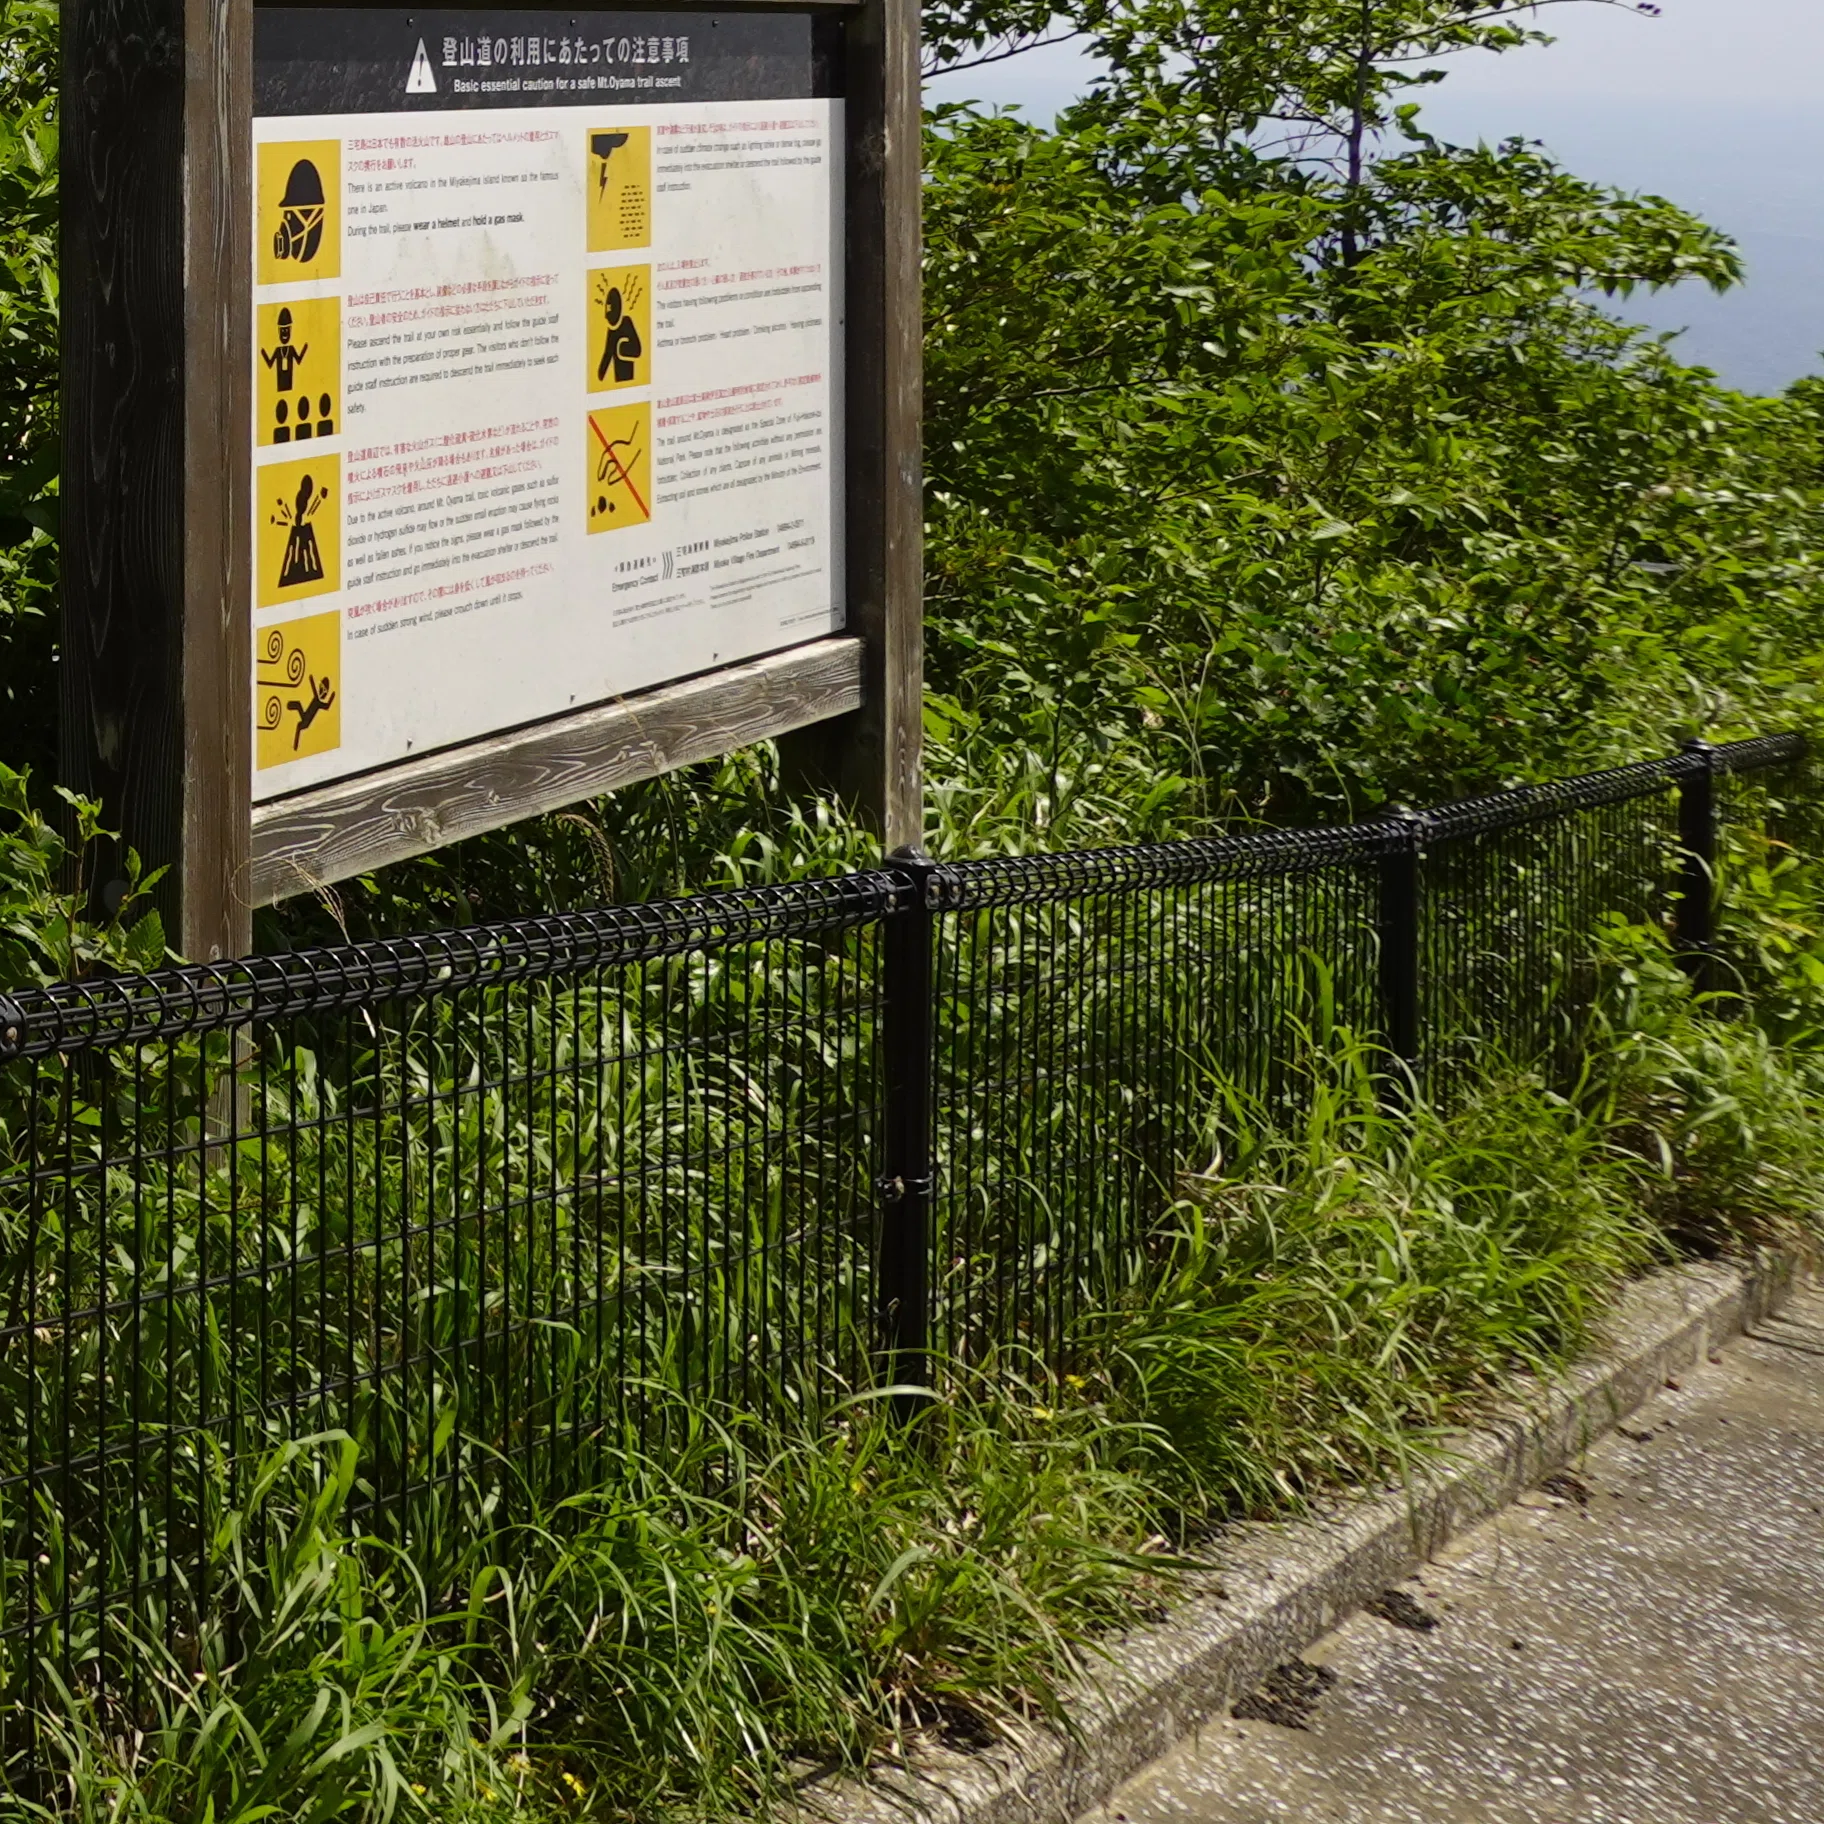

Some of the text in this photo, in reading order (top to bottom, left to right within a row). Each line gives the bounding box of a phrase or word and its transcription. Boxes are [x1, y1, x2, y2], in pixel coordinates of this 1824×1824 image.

[441, 36, 690, 67] 登山道の利用にあたっての注意事項
[454, 75, 681, 93] Basic essential caution for a safe Mt.Oyama trail ascent
[413, 222, 430, 230] wear
[438, 218, 460, 228] helmet
[473, 215, 487, 225] hold
[494, 215, 505, 225] gas
